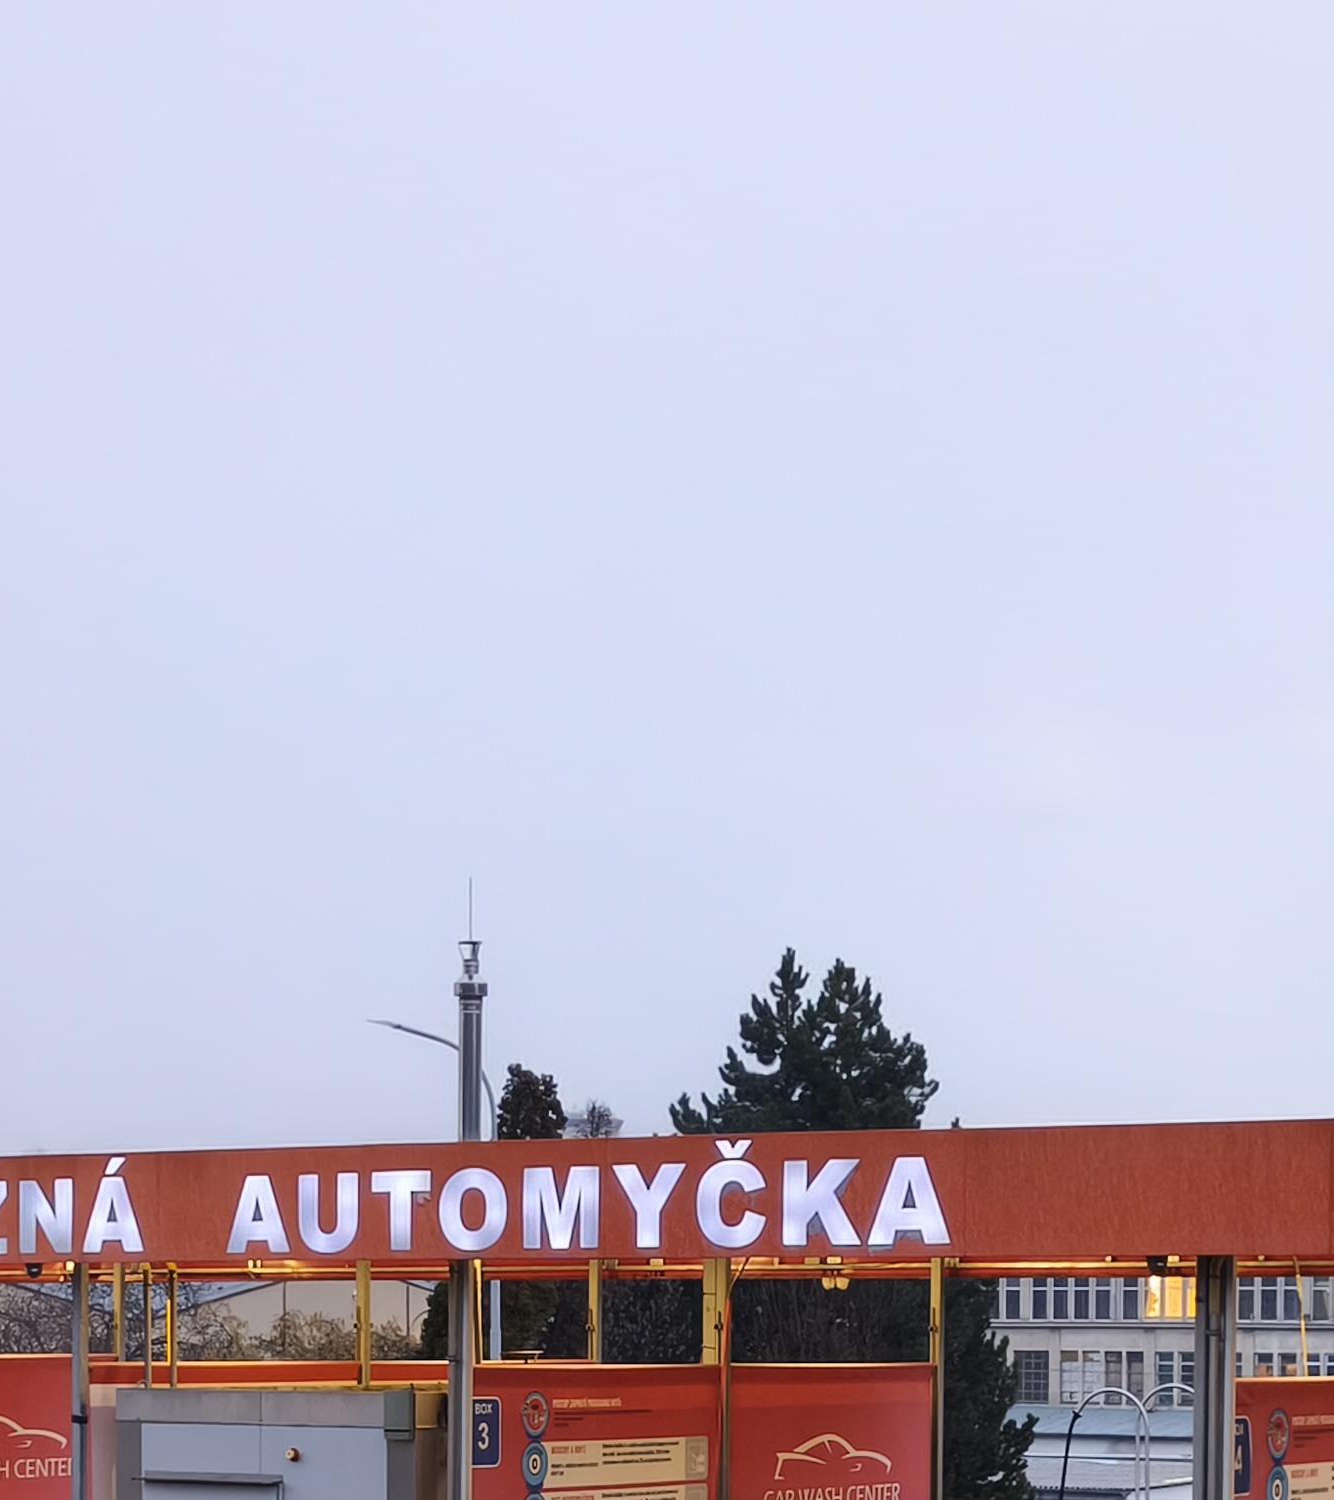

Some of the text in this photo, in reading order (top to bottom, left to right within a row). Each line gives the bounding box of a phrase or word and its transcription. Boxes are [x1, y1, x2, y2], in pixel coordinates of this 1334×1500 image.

[226, 1139, 952, 1255] AUTOMYČKA
[474, 1403, 494, 1415] BOX
[477, 1422, 490, 1450] 3
